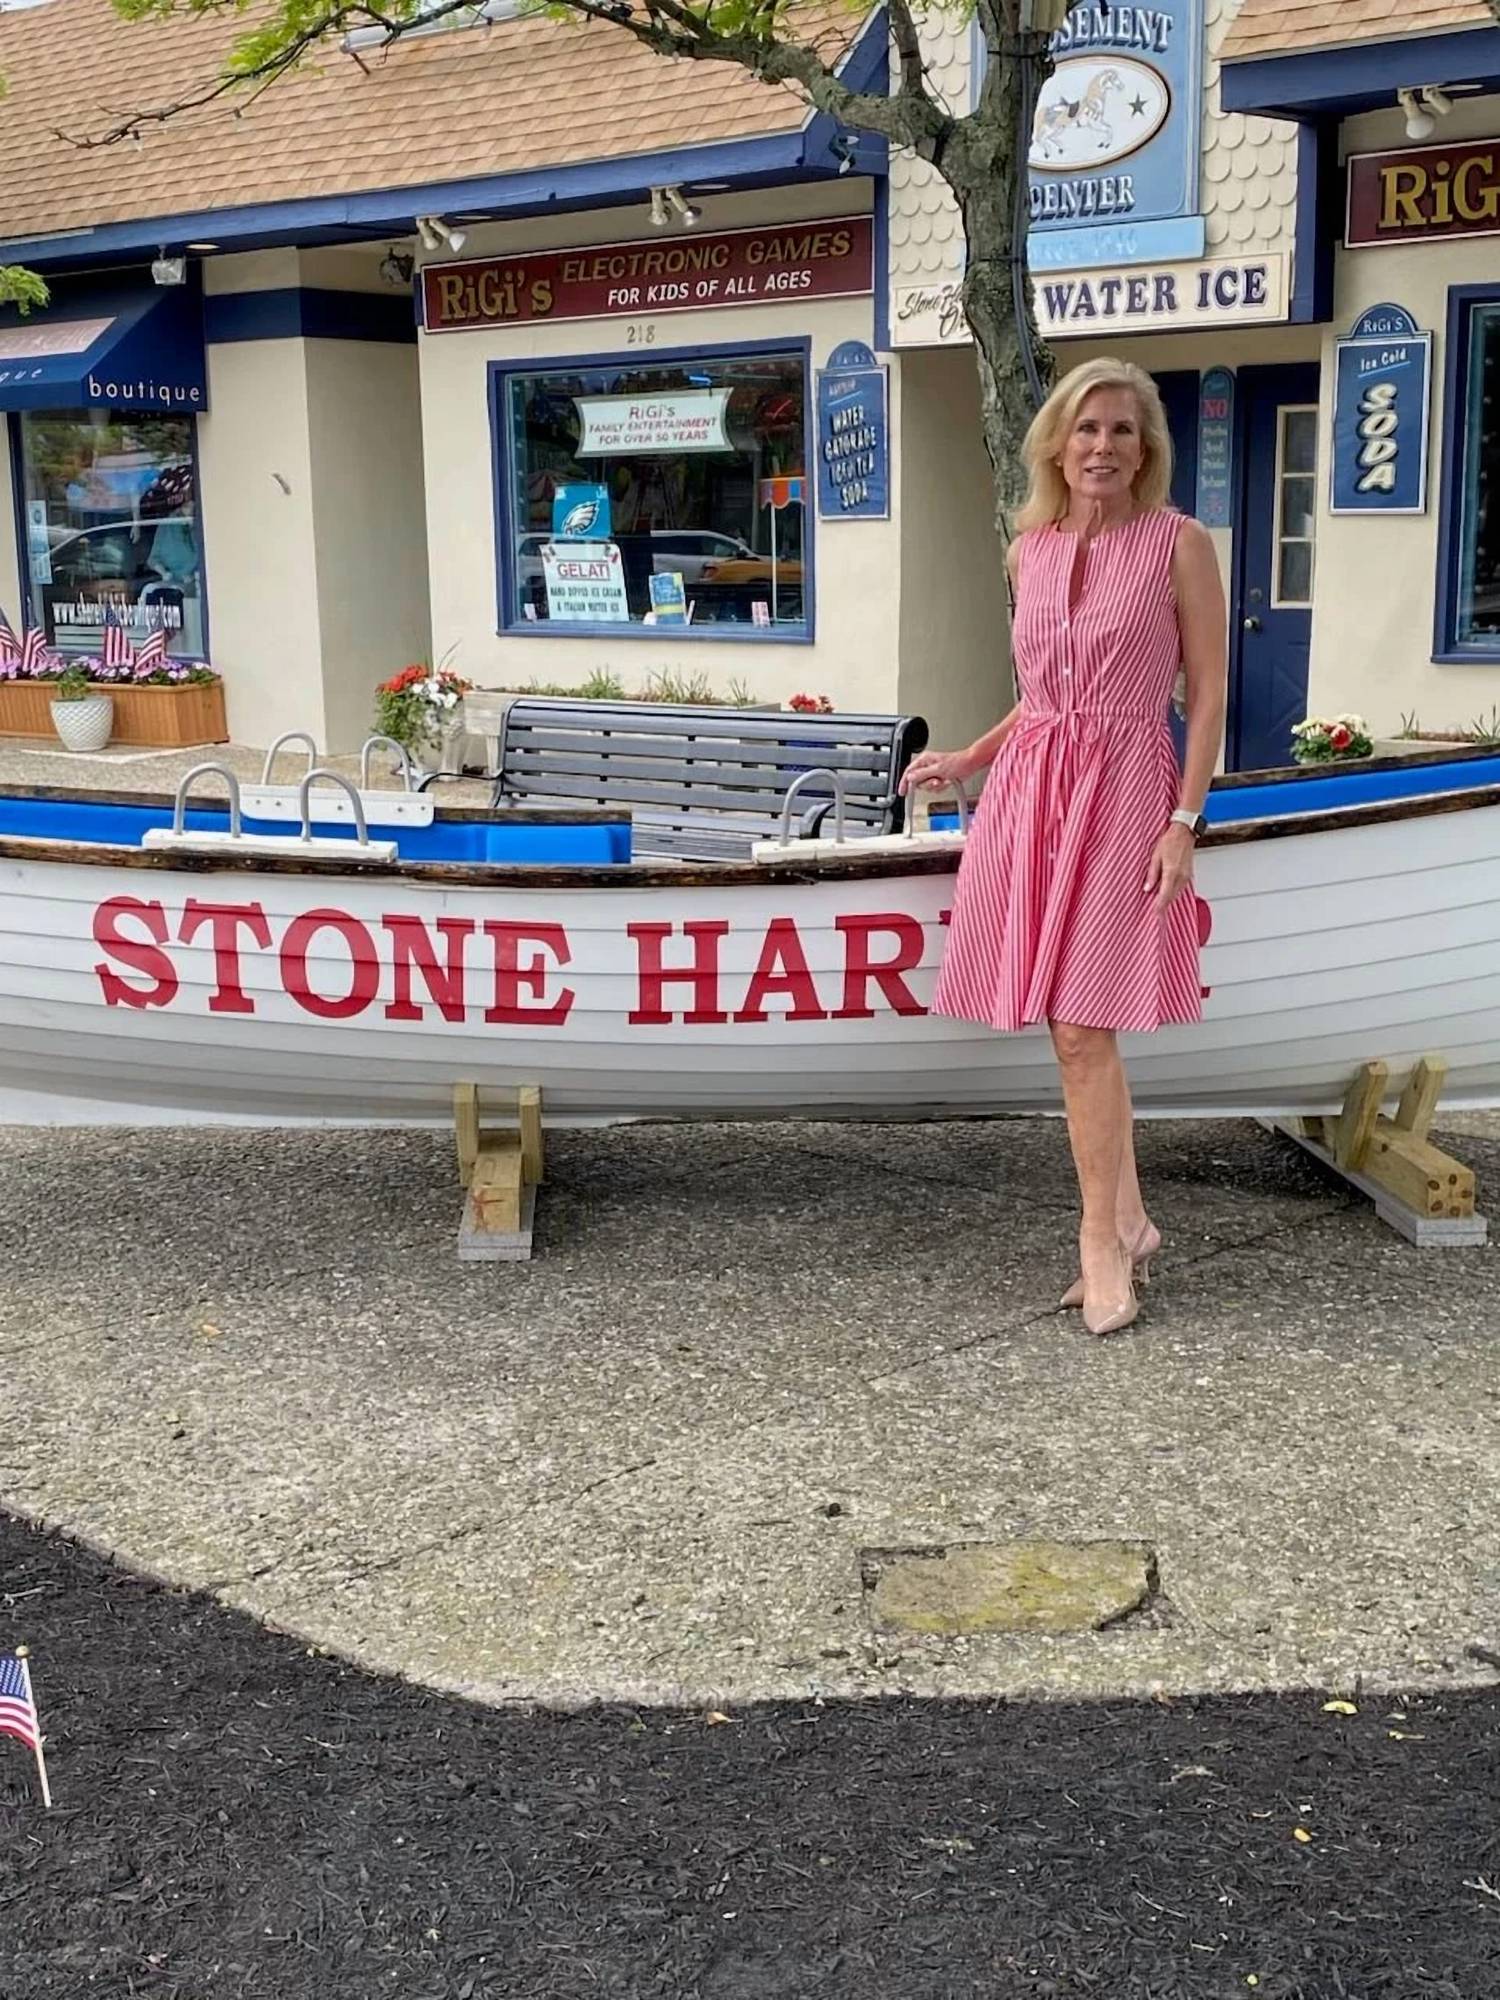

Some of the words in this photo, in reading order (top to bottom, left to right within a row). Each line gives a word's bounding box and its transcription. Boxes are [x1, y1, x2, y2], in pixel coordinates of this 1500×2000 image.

[1049, 6, 1174, 50] SEMENT
[437, 269, 553, 321] RiGi's
[562, 243, 730, 283] ELECTRONIC
[745, 230, 851, 265] GAMES
[607, 286, 640, 307] FOR
[646, 282, 689, 303] KIDS
[695, 279, 719, 299] OF
[724, 274, 757, 296] ALL
[764, 269, 813, 292] AGES
[1043, 273, 1177, 321] WATER
[1198, 267, 1268, 309] ICE
[627, 325, 656, 344] 218
[1381, 348, 1407, 367] Cold
[89, 374, 200, 407] boutique
[600, 433, 621, 445] FOR
[623, 433, 653, 445] OVER
[673, 430, 708, 442] YEARS
[627, 416, 718, 432] ENTERTAINMENT
[1357, 382, 1399, 494] SODA
[557, 563, 612, 578] GELATI
[92, 895, 576, 1027] STONE
